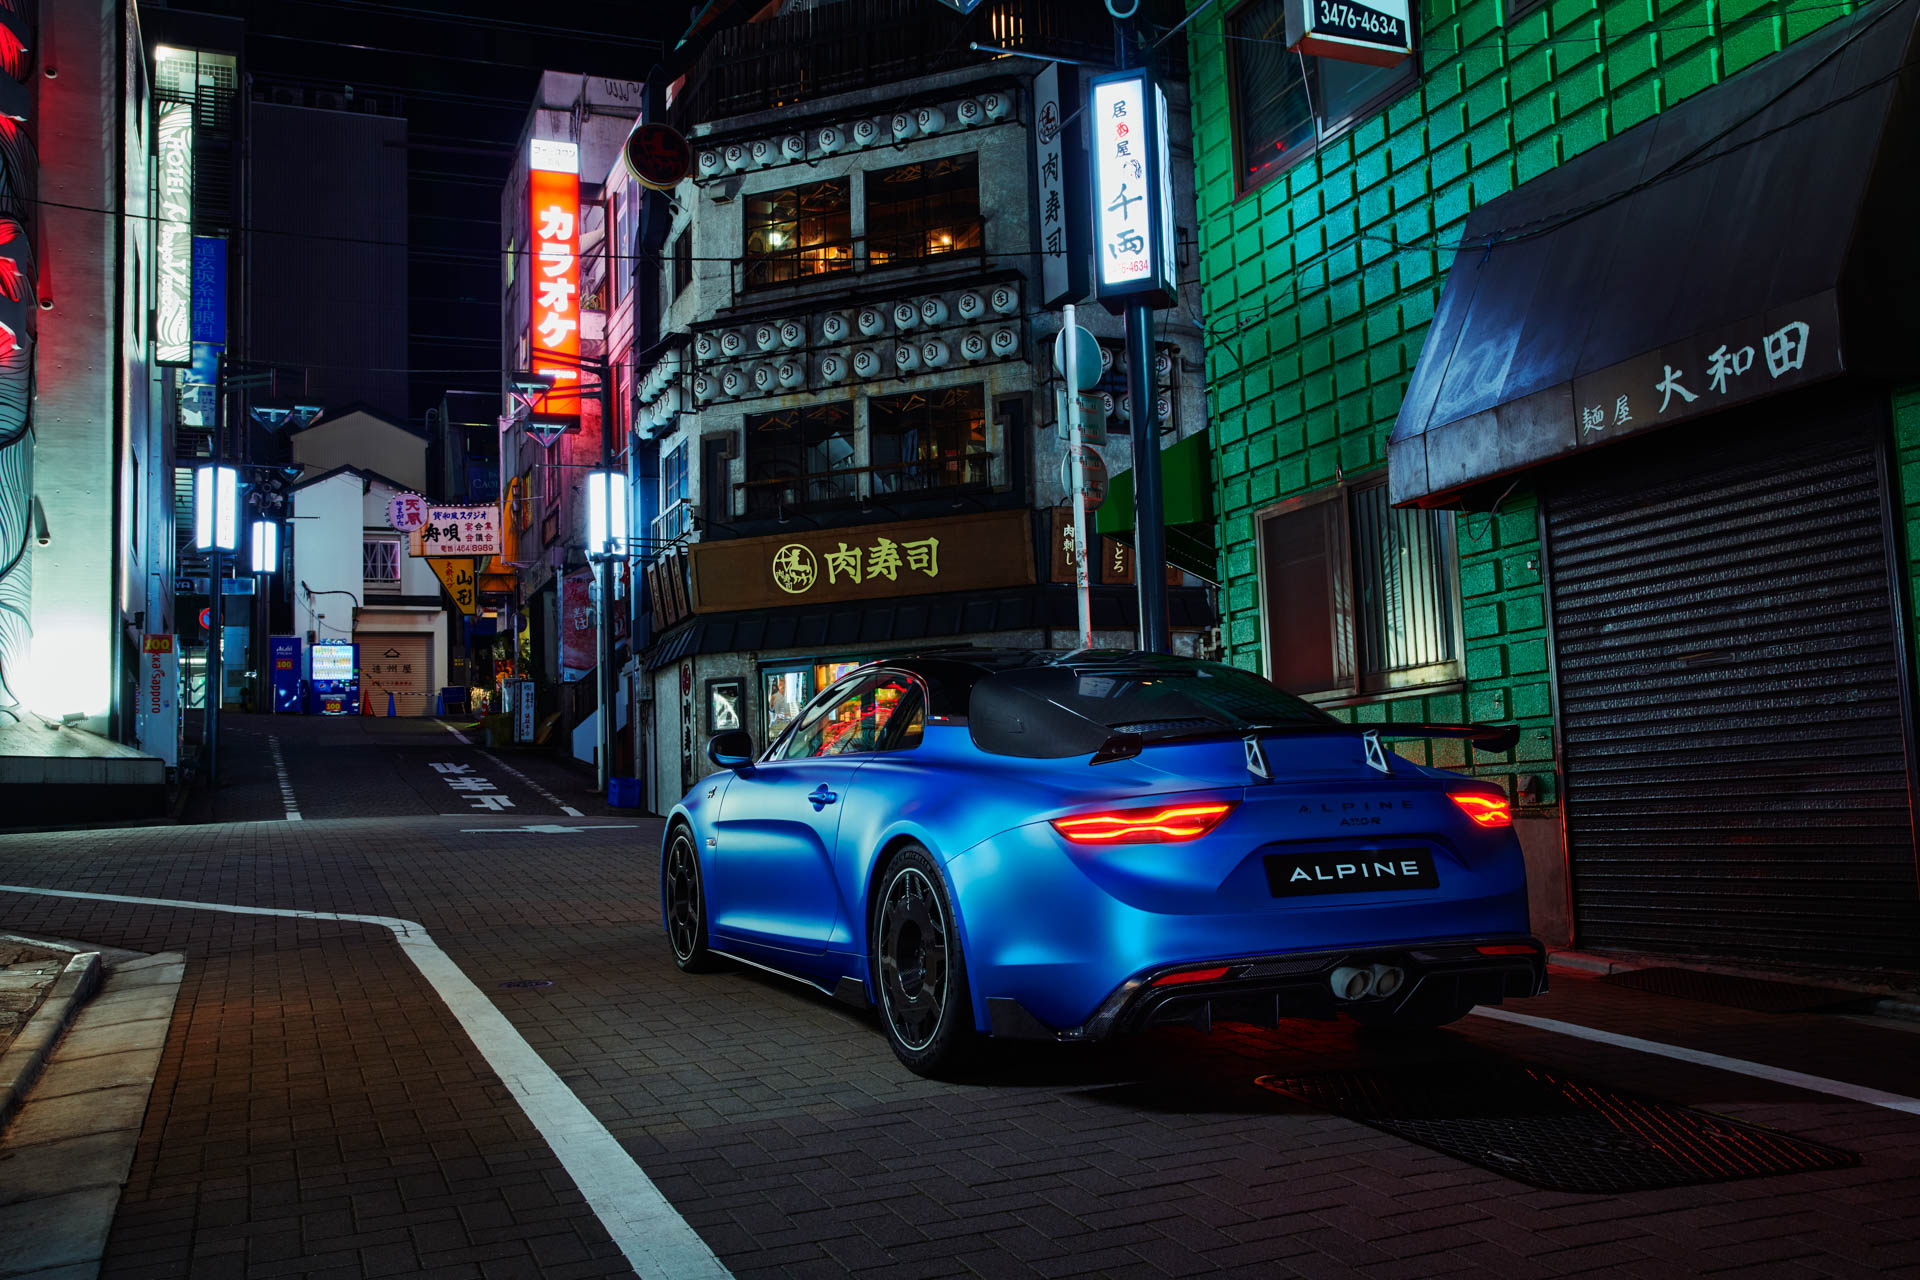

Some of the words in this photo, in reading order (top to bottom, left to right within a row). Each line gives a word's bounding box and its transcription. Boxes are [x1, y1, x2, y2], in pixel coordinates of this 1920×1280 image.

[1321, 0, 1398, 36] 3476-4634
[166, 131, 185, 196] HOTEL
[1042, 153, 1061, 258] 肉寿司
[538, 206, 576, 347] カラオケ
[1583, 394, 1632, 436] 麺屋
[1656, 321, 1810, 414] 大和田
[422, 523, 461, 542] 舟唄
[1063, 524, 1075, 565] 肉刺し
[823, 537, 939, 585] 肉寿司
[456, 569, 473, 606] 山形
[144, 639, 170, 650] 100
[278, 660, 292, 668] 100
[1299, 800, 1414, 816] ALPINE
[1289, 860, 1420, 883] ALPINE
